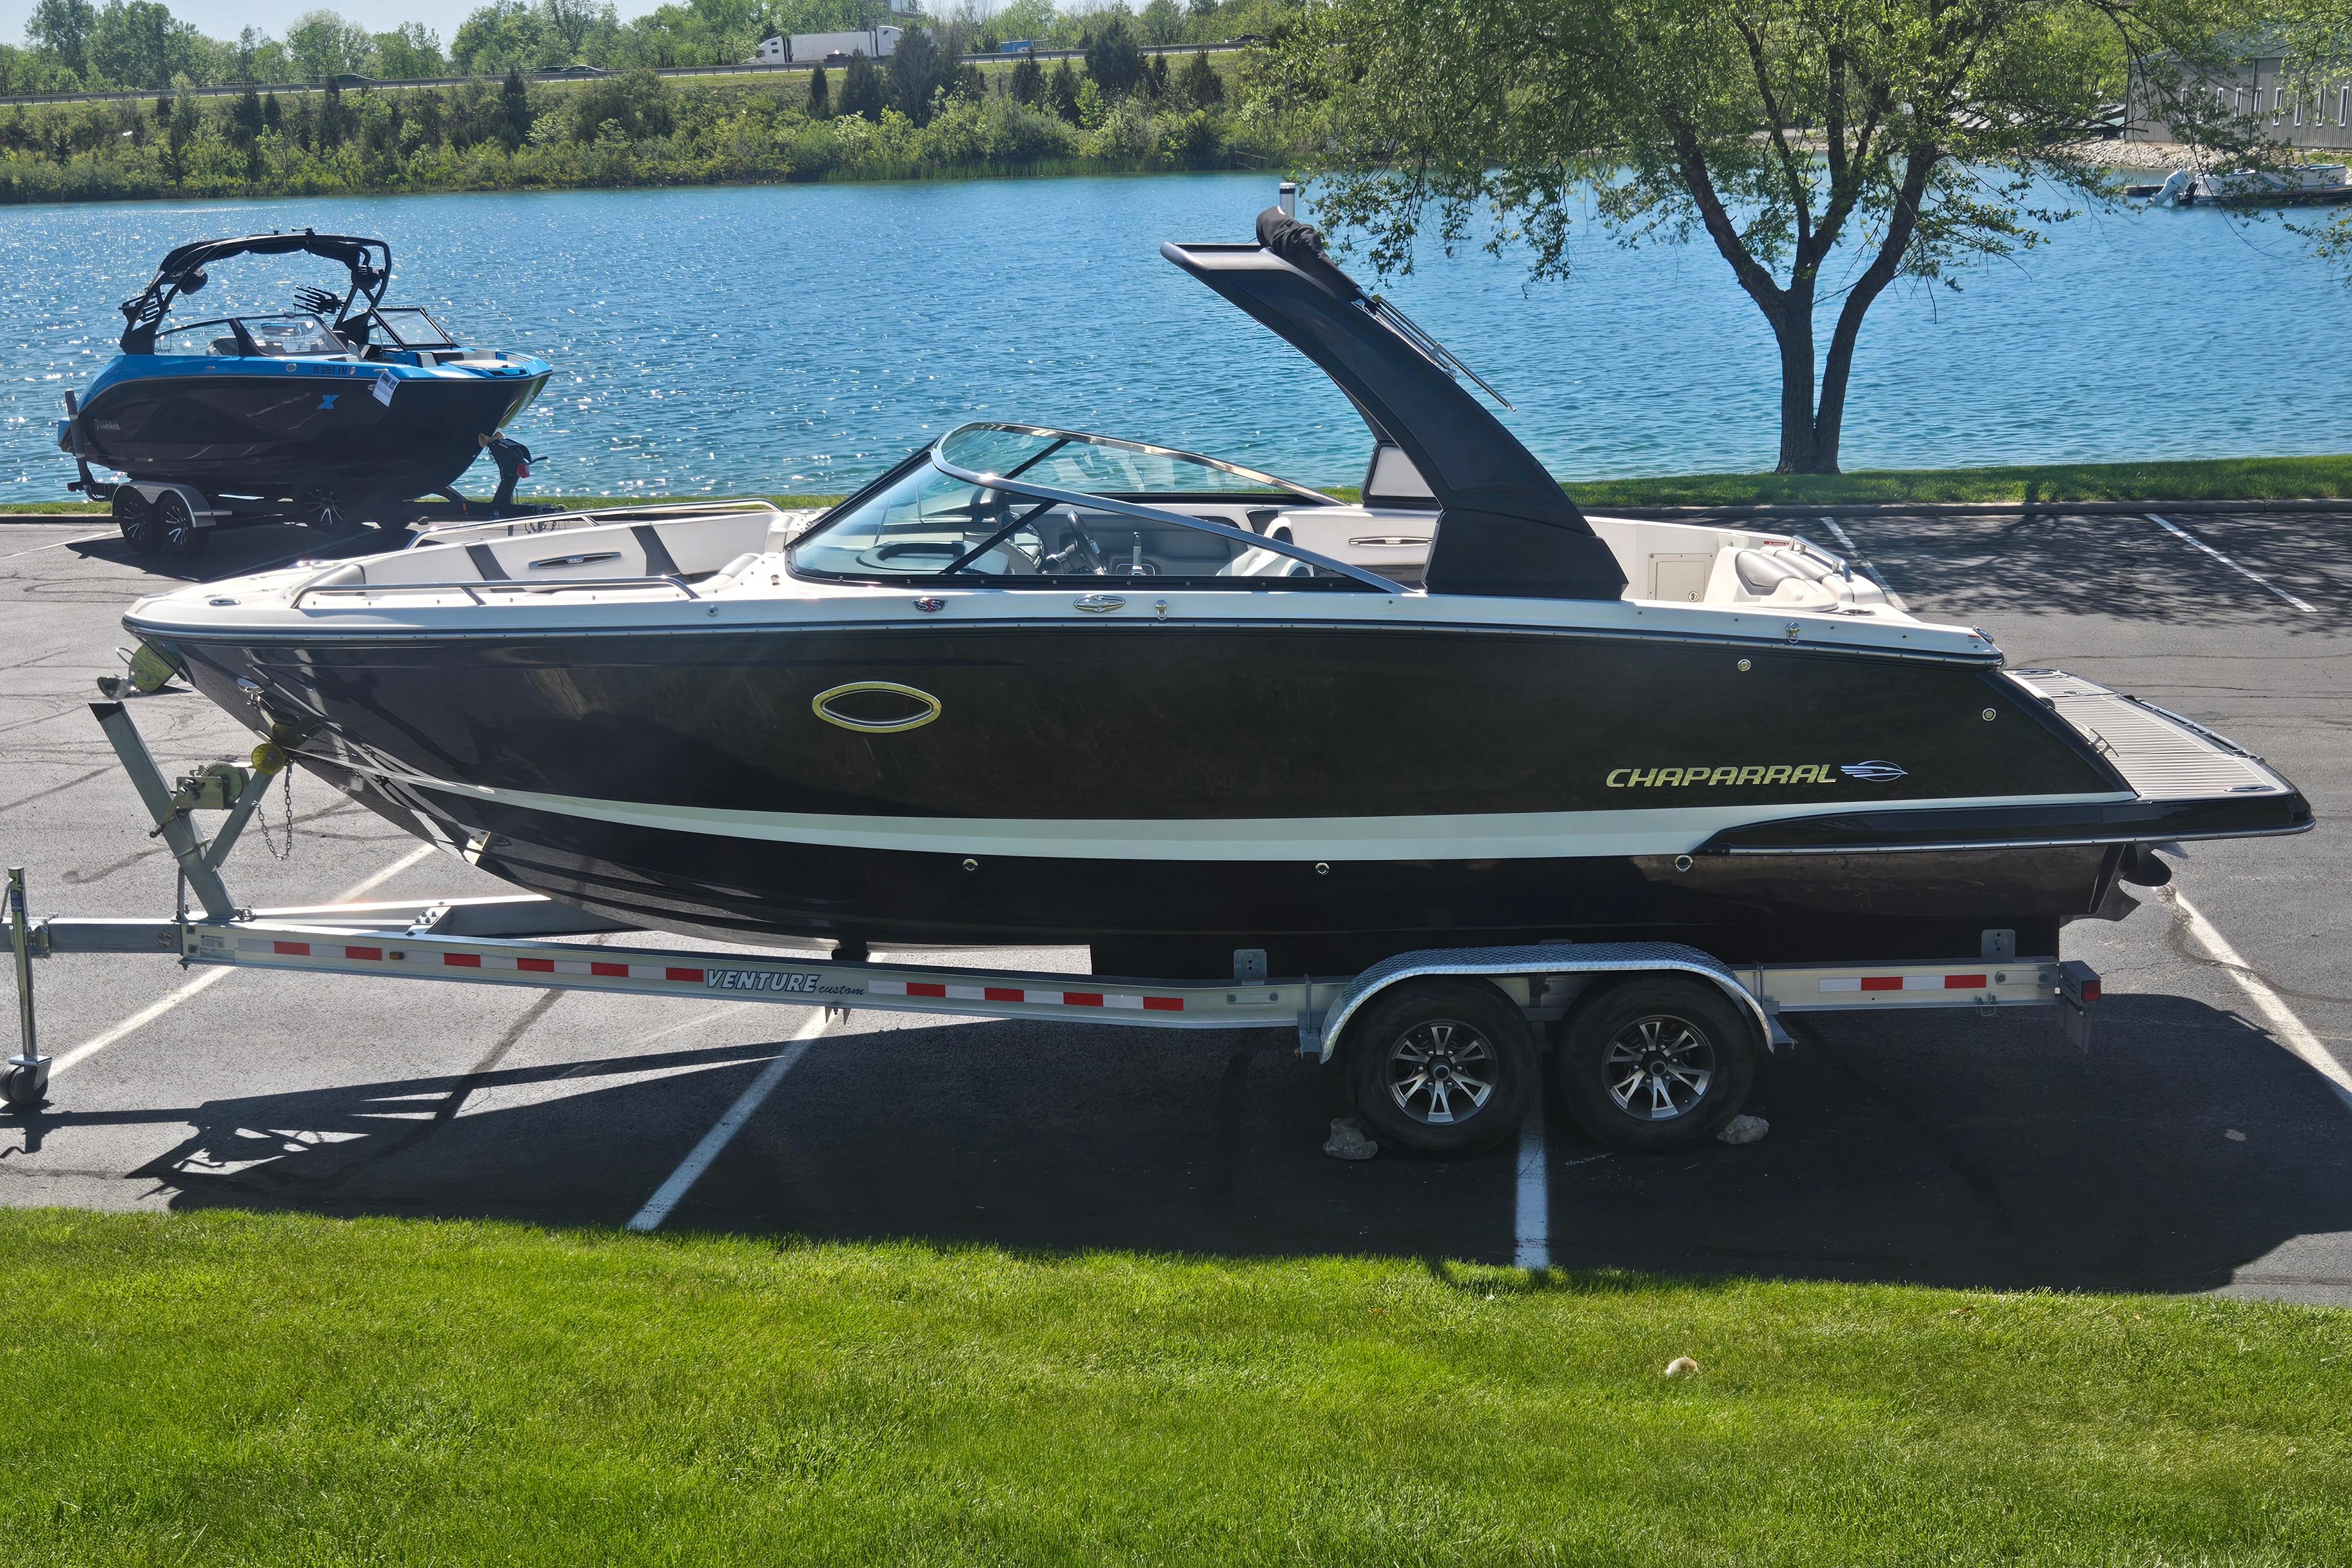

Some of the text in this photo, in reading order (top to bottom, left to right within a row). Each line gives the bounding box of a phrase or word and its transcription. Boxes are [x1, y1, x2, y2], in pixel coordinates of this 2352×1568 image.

[1606, 764, 1836, 787] CHAPARRAL
[707, 968, 866, 995] VENTURE custom
